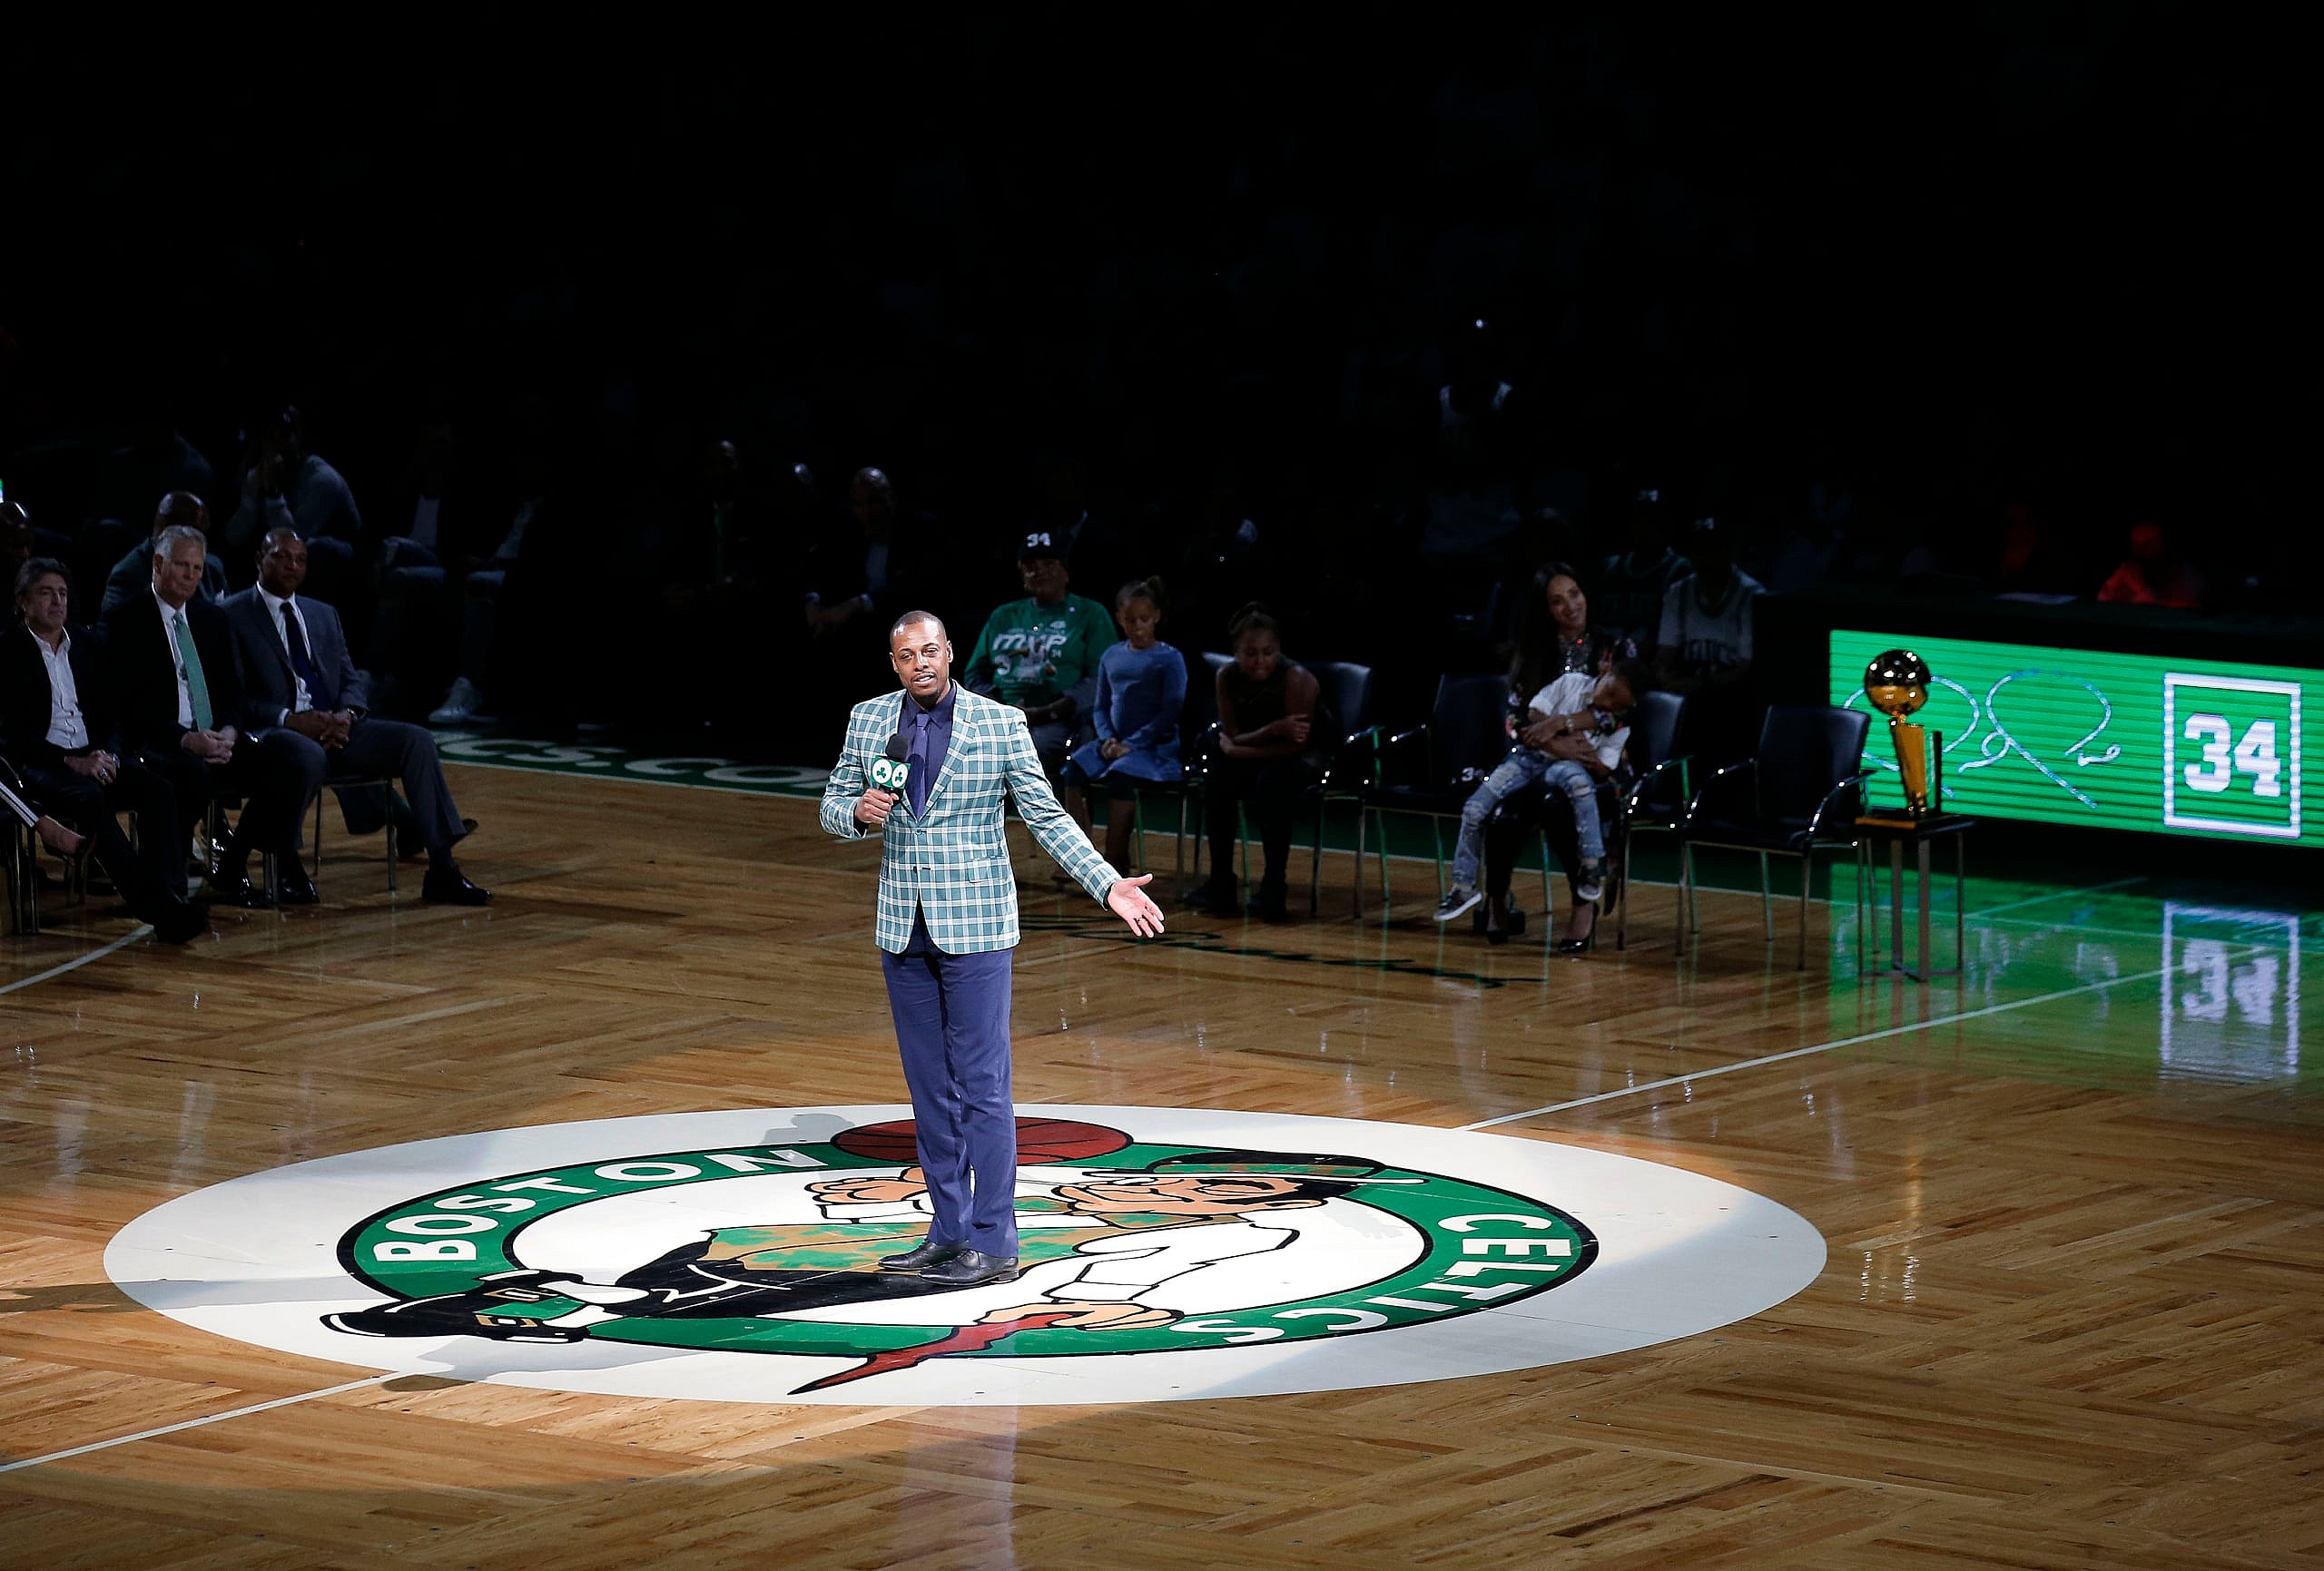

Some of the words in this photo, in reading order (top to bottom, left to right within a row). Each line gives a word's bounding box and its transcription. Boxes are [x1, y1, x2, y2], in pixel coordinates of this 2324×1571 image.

[1027, 533, 1051, 548] 34
[2183, 712, 2280, 797] 34
[371, 1149, 827, 1262] BOSTON
[1169, 1213, 1571, 1342] CELTICS
